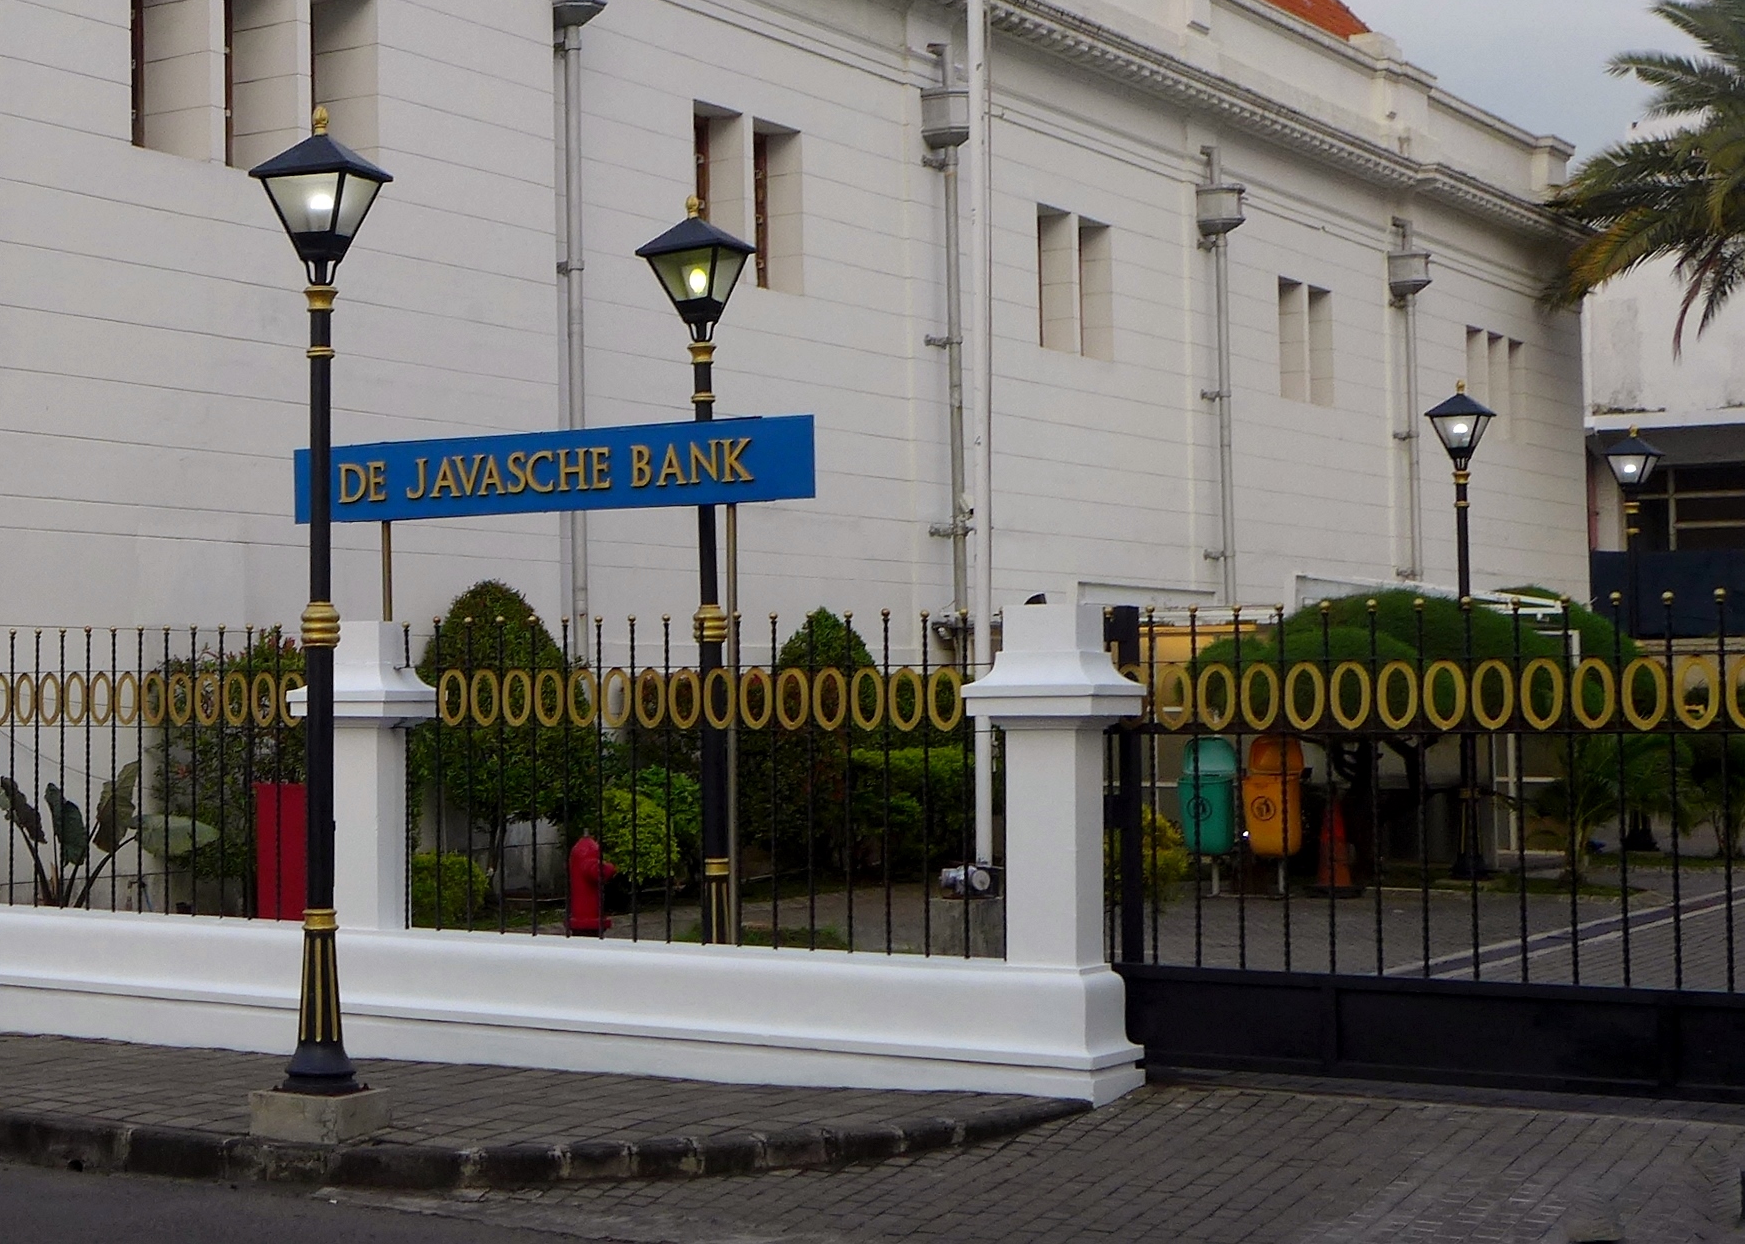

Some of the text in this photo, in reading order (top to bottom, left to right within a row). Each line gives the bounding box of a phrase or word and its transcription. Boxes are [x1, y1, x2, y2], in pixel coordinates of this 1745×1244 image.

[338, 437, 755, 504] DE JAVASCHE BANK
